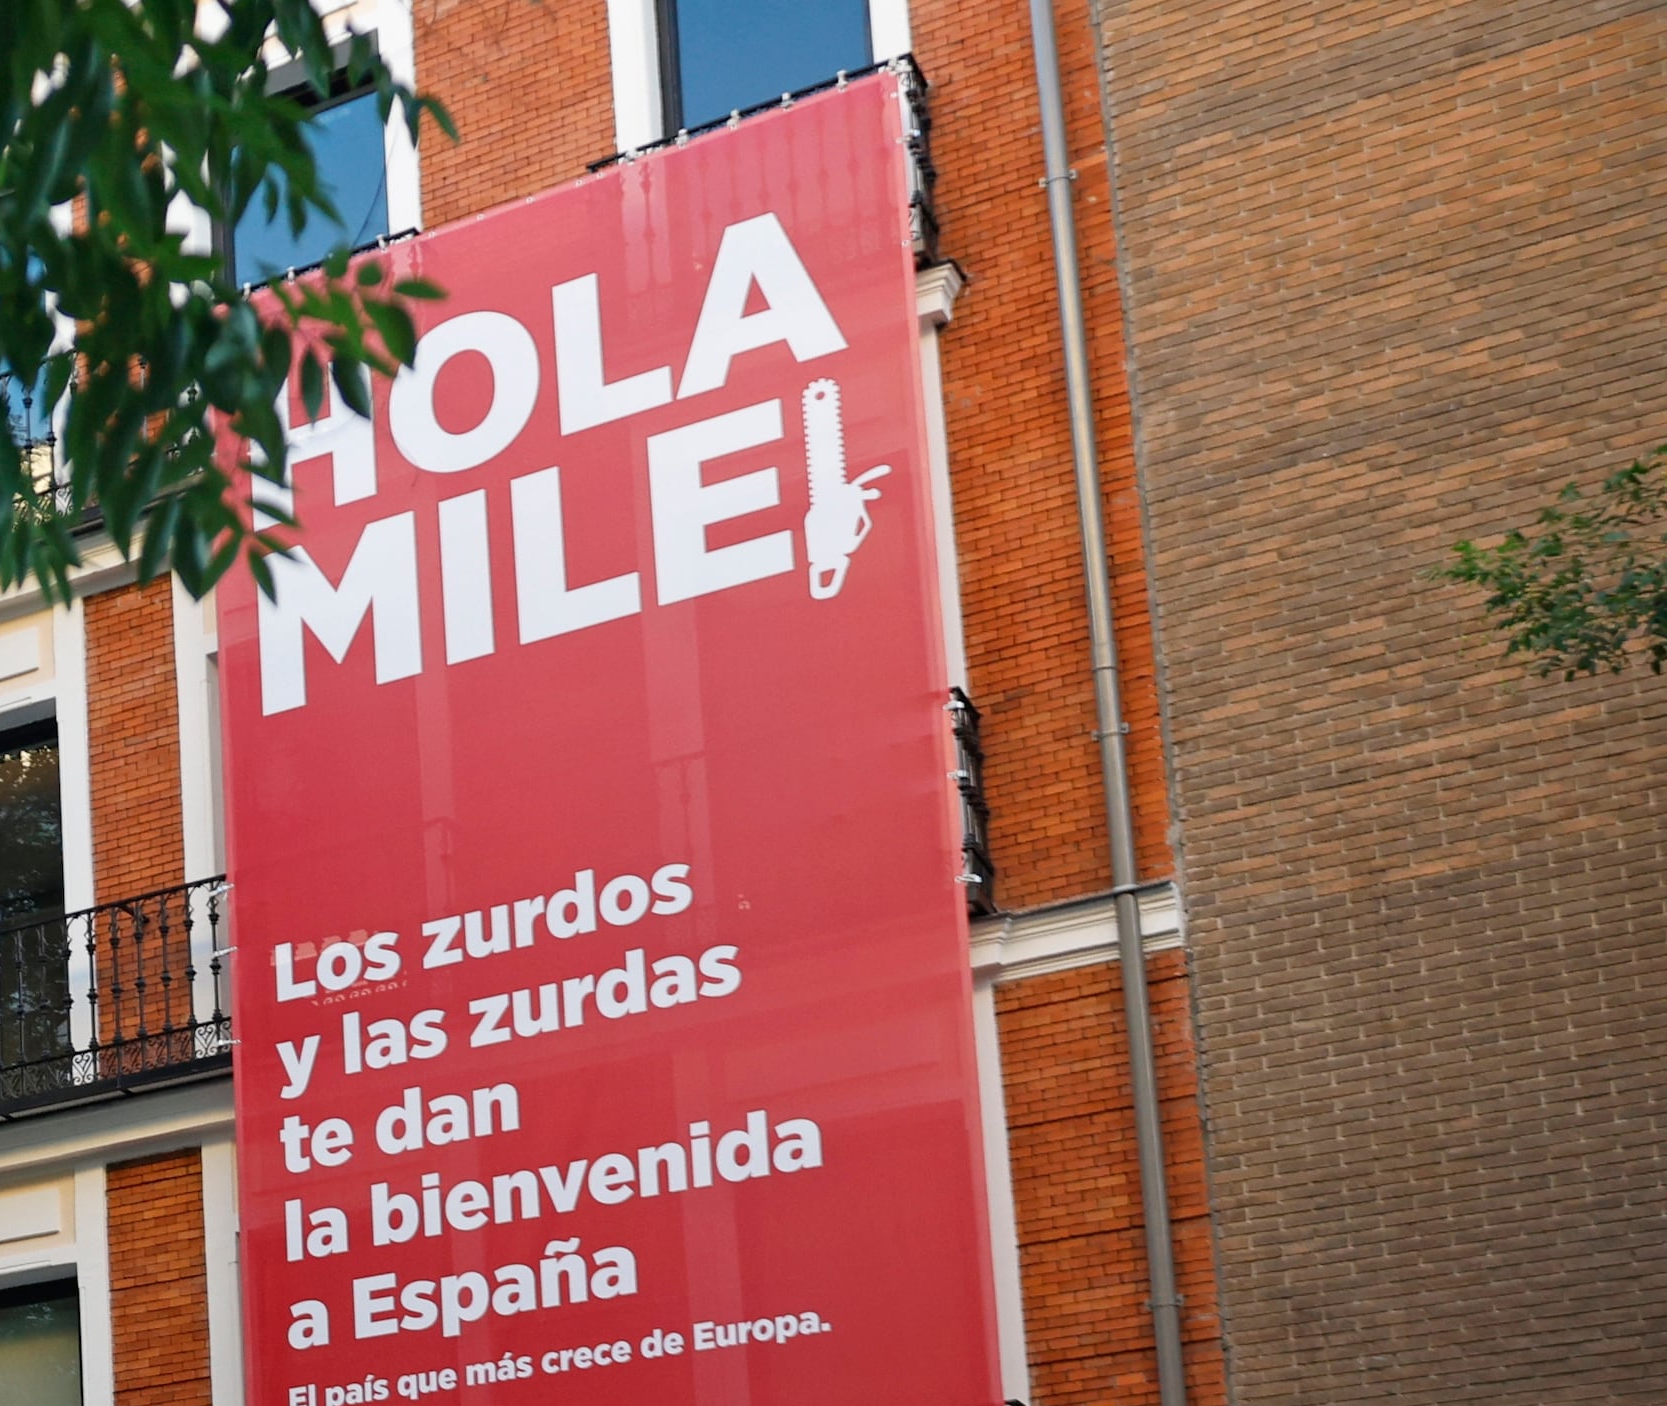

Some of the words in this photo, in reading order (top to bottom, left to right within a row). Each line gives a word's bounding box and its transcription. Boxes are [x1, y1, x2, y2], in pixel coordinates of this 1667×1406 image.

[250, 213, 848, 533] HOLA
[275, 933, 400, 1001] Los
[422, 864, 692, 968] zurdos
[276, 1036, 319, 1098] y
[343, 1010, 447, 1073] las
[470, 946, 740, 1047] zurdas
[280, 1116, 353, 1172] te
[376, 1084, 518, 1154] dan
[286, 1200, 347, 1261] la
[372, 1110, 821, 1245] bienvenida
[288, 1301, 328, 1350] a
[354, 1238, 636, 1338] España
[398, 1368, 456, 1400] que
[467, 1353, 532, 1385] más
[542, 1341, 629, 1373] crece
[641, 1328, 683, 1357] de
[694, 1311, 831, 1350] Europa.
